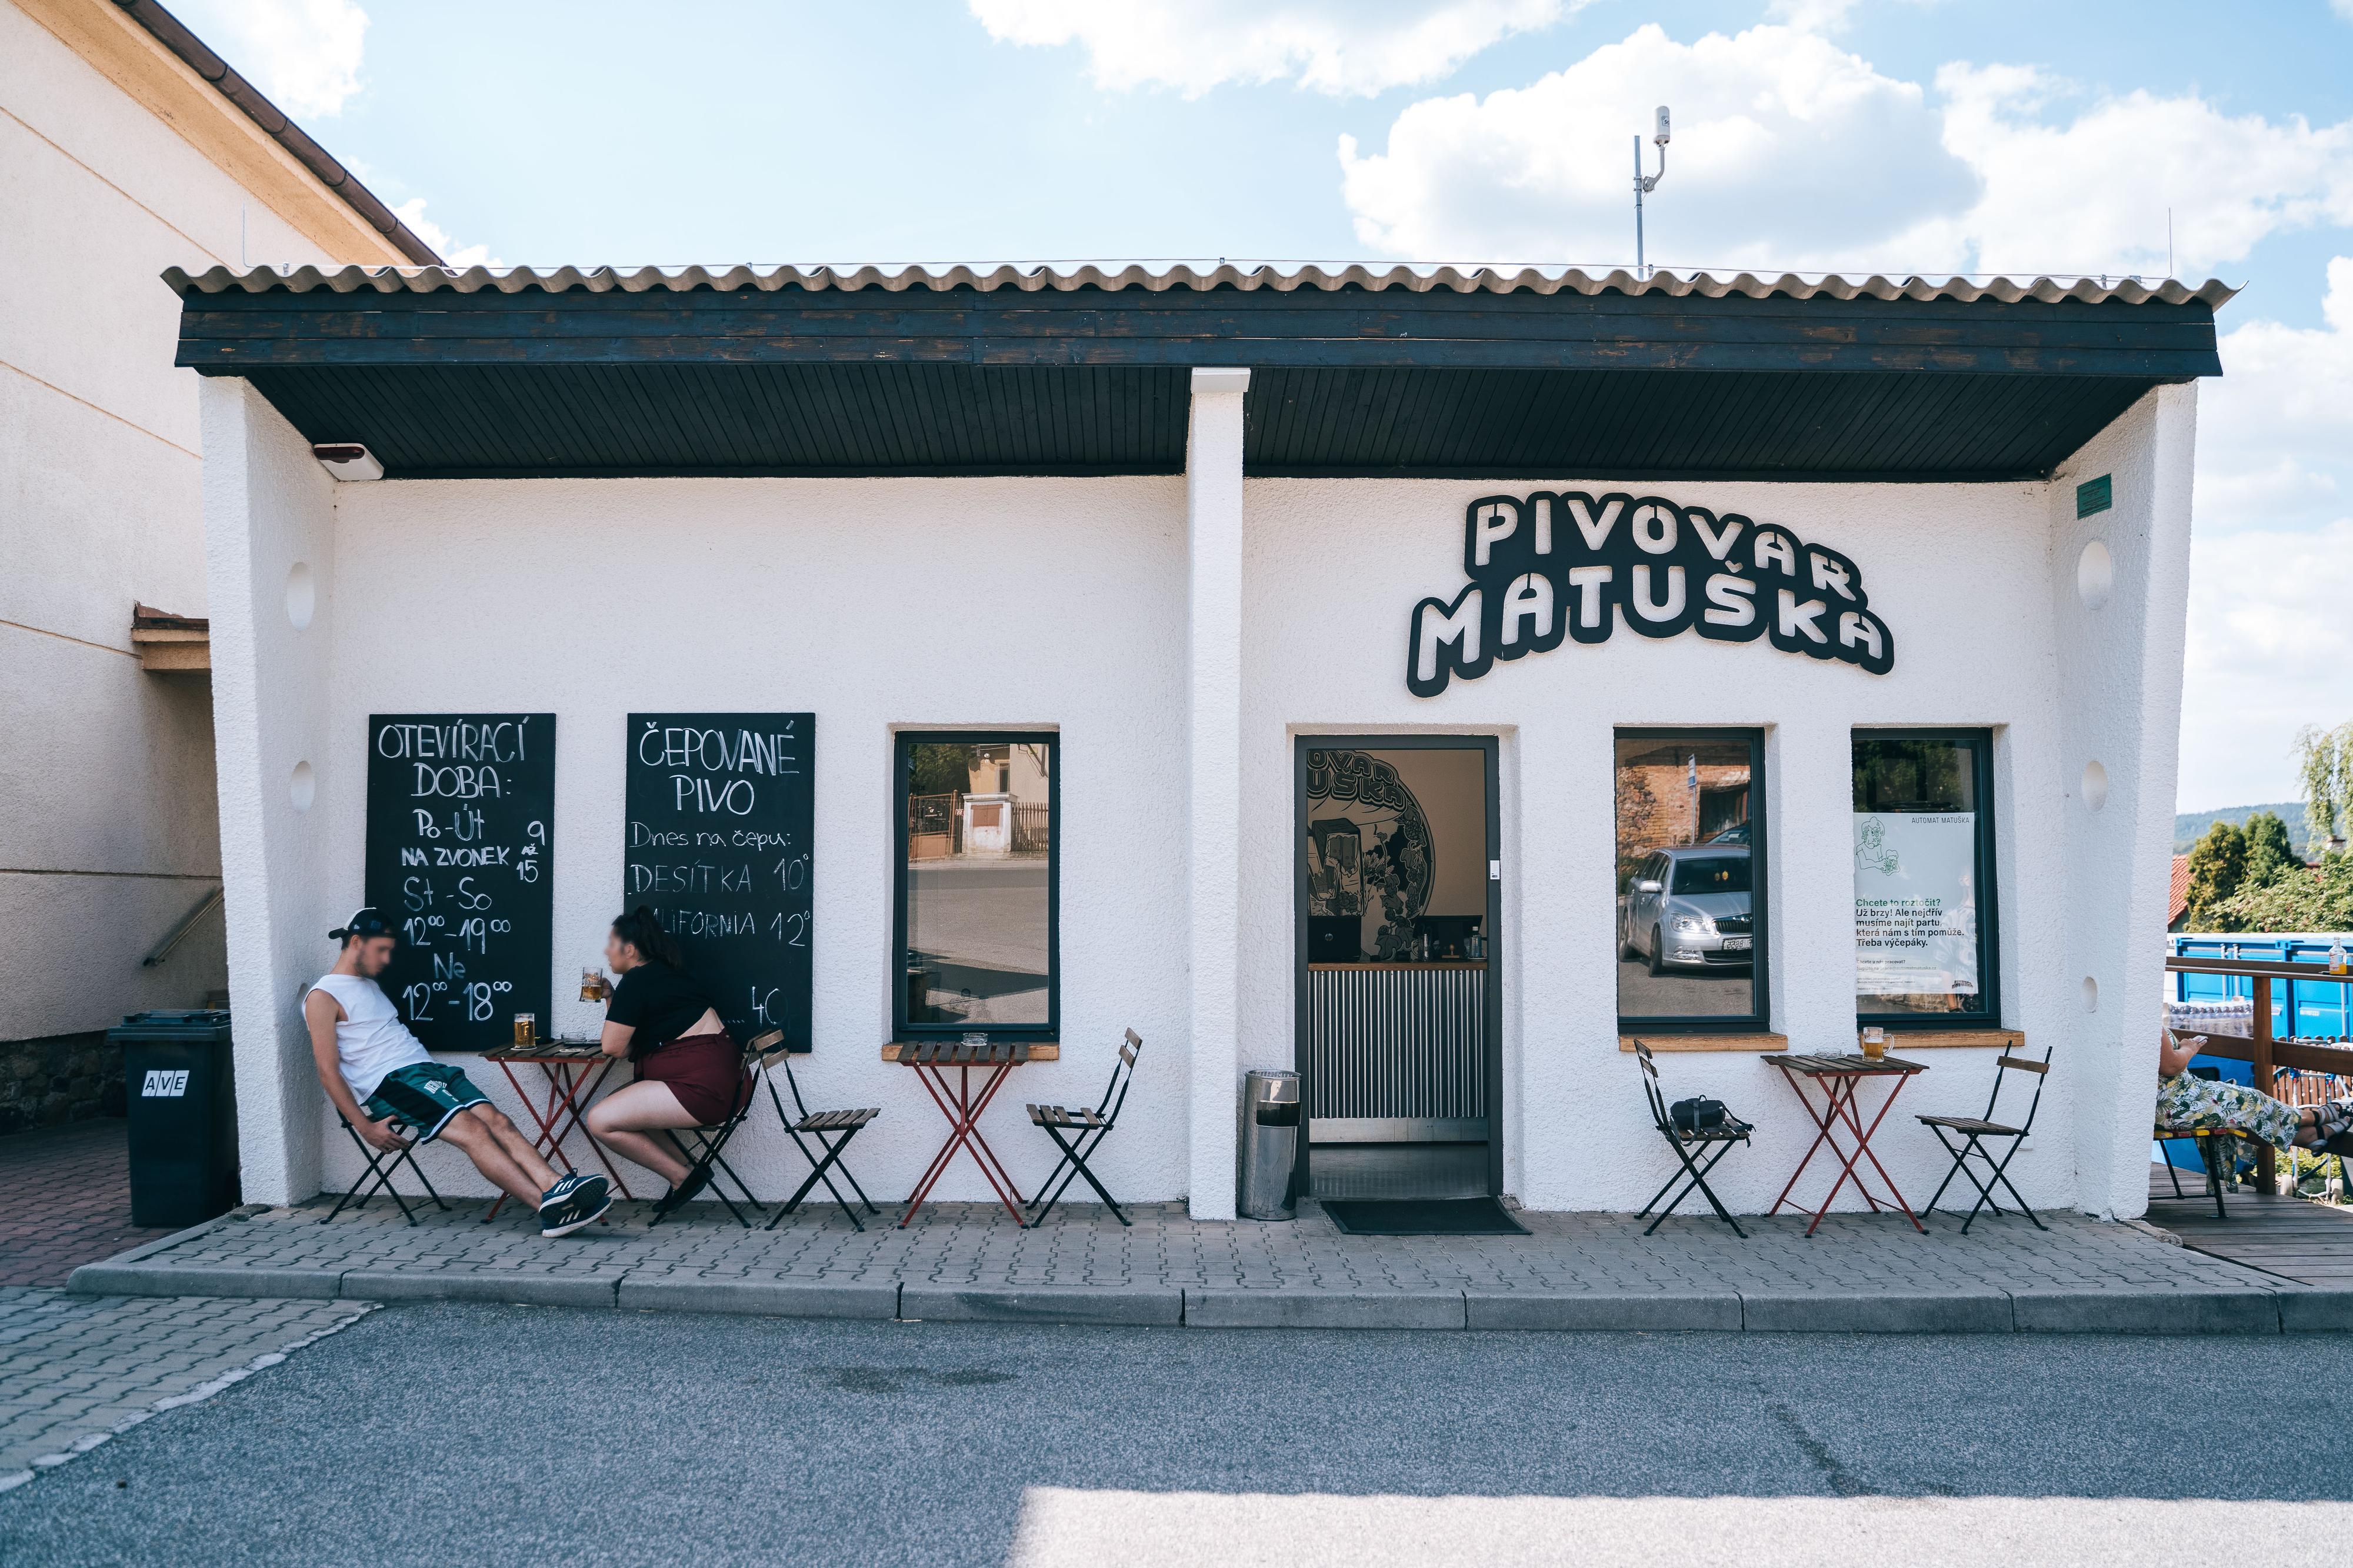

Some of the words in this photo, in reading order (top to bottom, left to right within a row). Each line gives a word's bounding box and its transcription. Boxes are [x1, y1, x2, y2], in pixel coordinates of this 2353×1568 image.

[1472, 497, 1857, 602] PIVOVAR
[1416, 559, 1884, 682] MATUŠKA
[379, 716, 529, 763] OTEVÍRACÍ
[639, 719, 799, 776] ČEPOVANÉ
[411, 762, 512, 798] DOBA:
[1308, 750, 1394, 785] OVAR
[669, 775, 755, 815] PIVO
[1308, 768, 1404, 806] UŠKA
[527, 820, 545, 846] 9
[1941, 816, 1969, 824] MATUŠKA
[629, 822, 689, 846] Dnes
[696, 832, 726, 847] na
[732, 830, 791, 851] čepu:
[402, 847, 429, 866] NA
[434, 846, 510, 867] ZVONEK
[516, 859, 538, 882] 15
[630, 859, 752, 893] DESÍTKA
[1856, 899, 1888, 907] Chcete
[1901, 899, 1941, 907] roztočit?
[1856, 909, 1868, 917] Už
[1871, 909, 1892, 918] brzy!
[1912, 908, 1942, 918] nejdřív
[1882, 928, 1901, 936] nám
[1911, 928, 1925, 936] tím
[1928, 928, 1964, 938] pomůže.
[1895, 918, 1914, 928] najít
[1917, 919, 1942, 928] partu,
[1857, 938, 1882, 946] Třeba
[1885, 939, 1928, 948] výčepáky.
[434, 952, 466, 979] Ne
[145, 1076, 186, 1090] AVE
